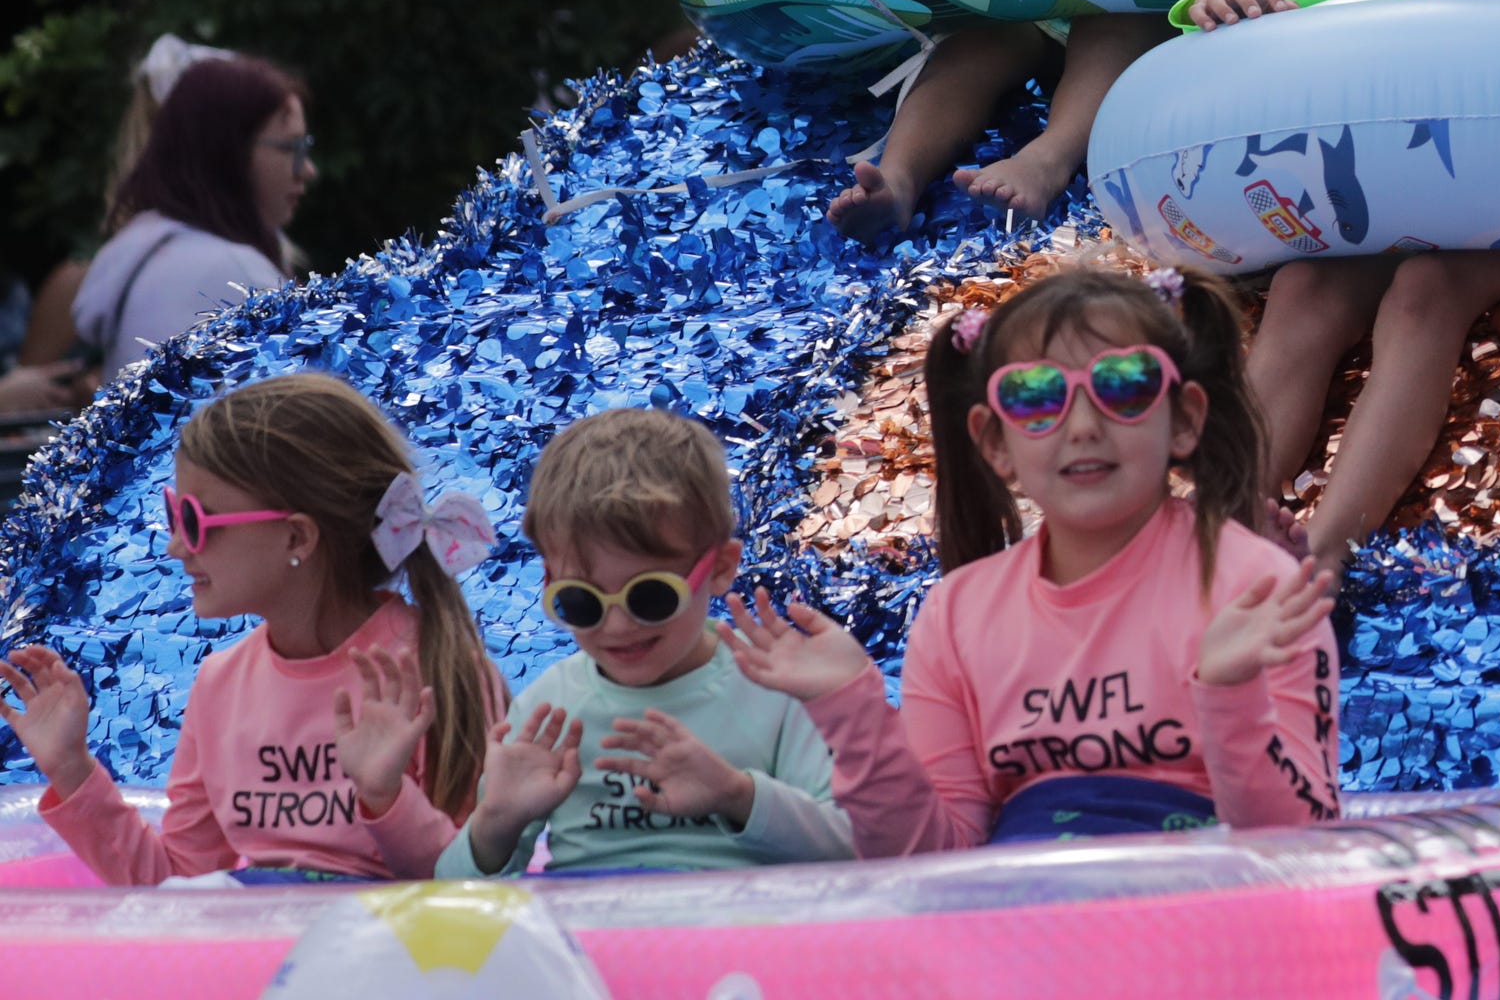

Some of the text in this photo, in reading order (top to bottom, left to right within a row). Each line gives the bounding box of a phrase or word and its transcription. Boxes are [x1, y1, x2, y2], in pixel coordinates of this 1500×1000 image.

[1020, 670, 1145, 729] SWFL
[258, 743, 350, 783] SWF
[989, 719, 1192, 777] STRONG
[232, 787, 356, 829] STRON
[584, 802, 716, 831] STRO
